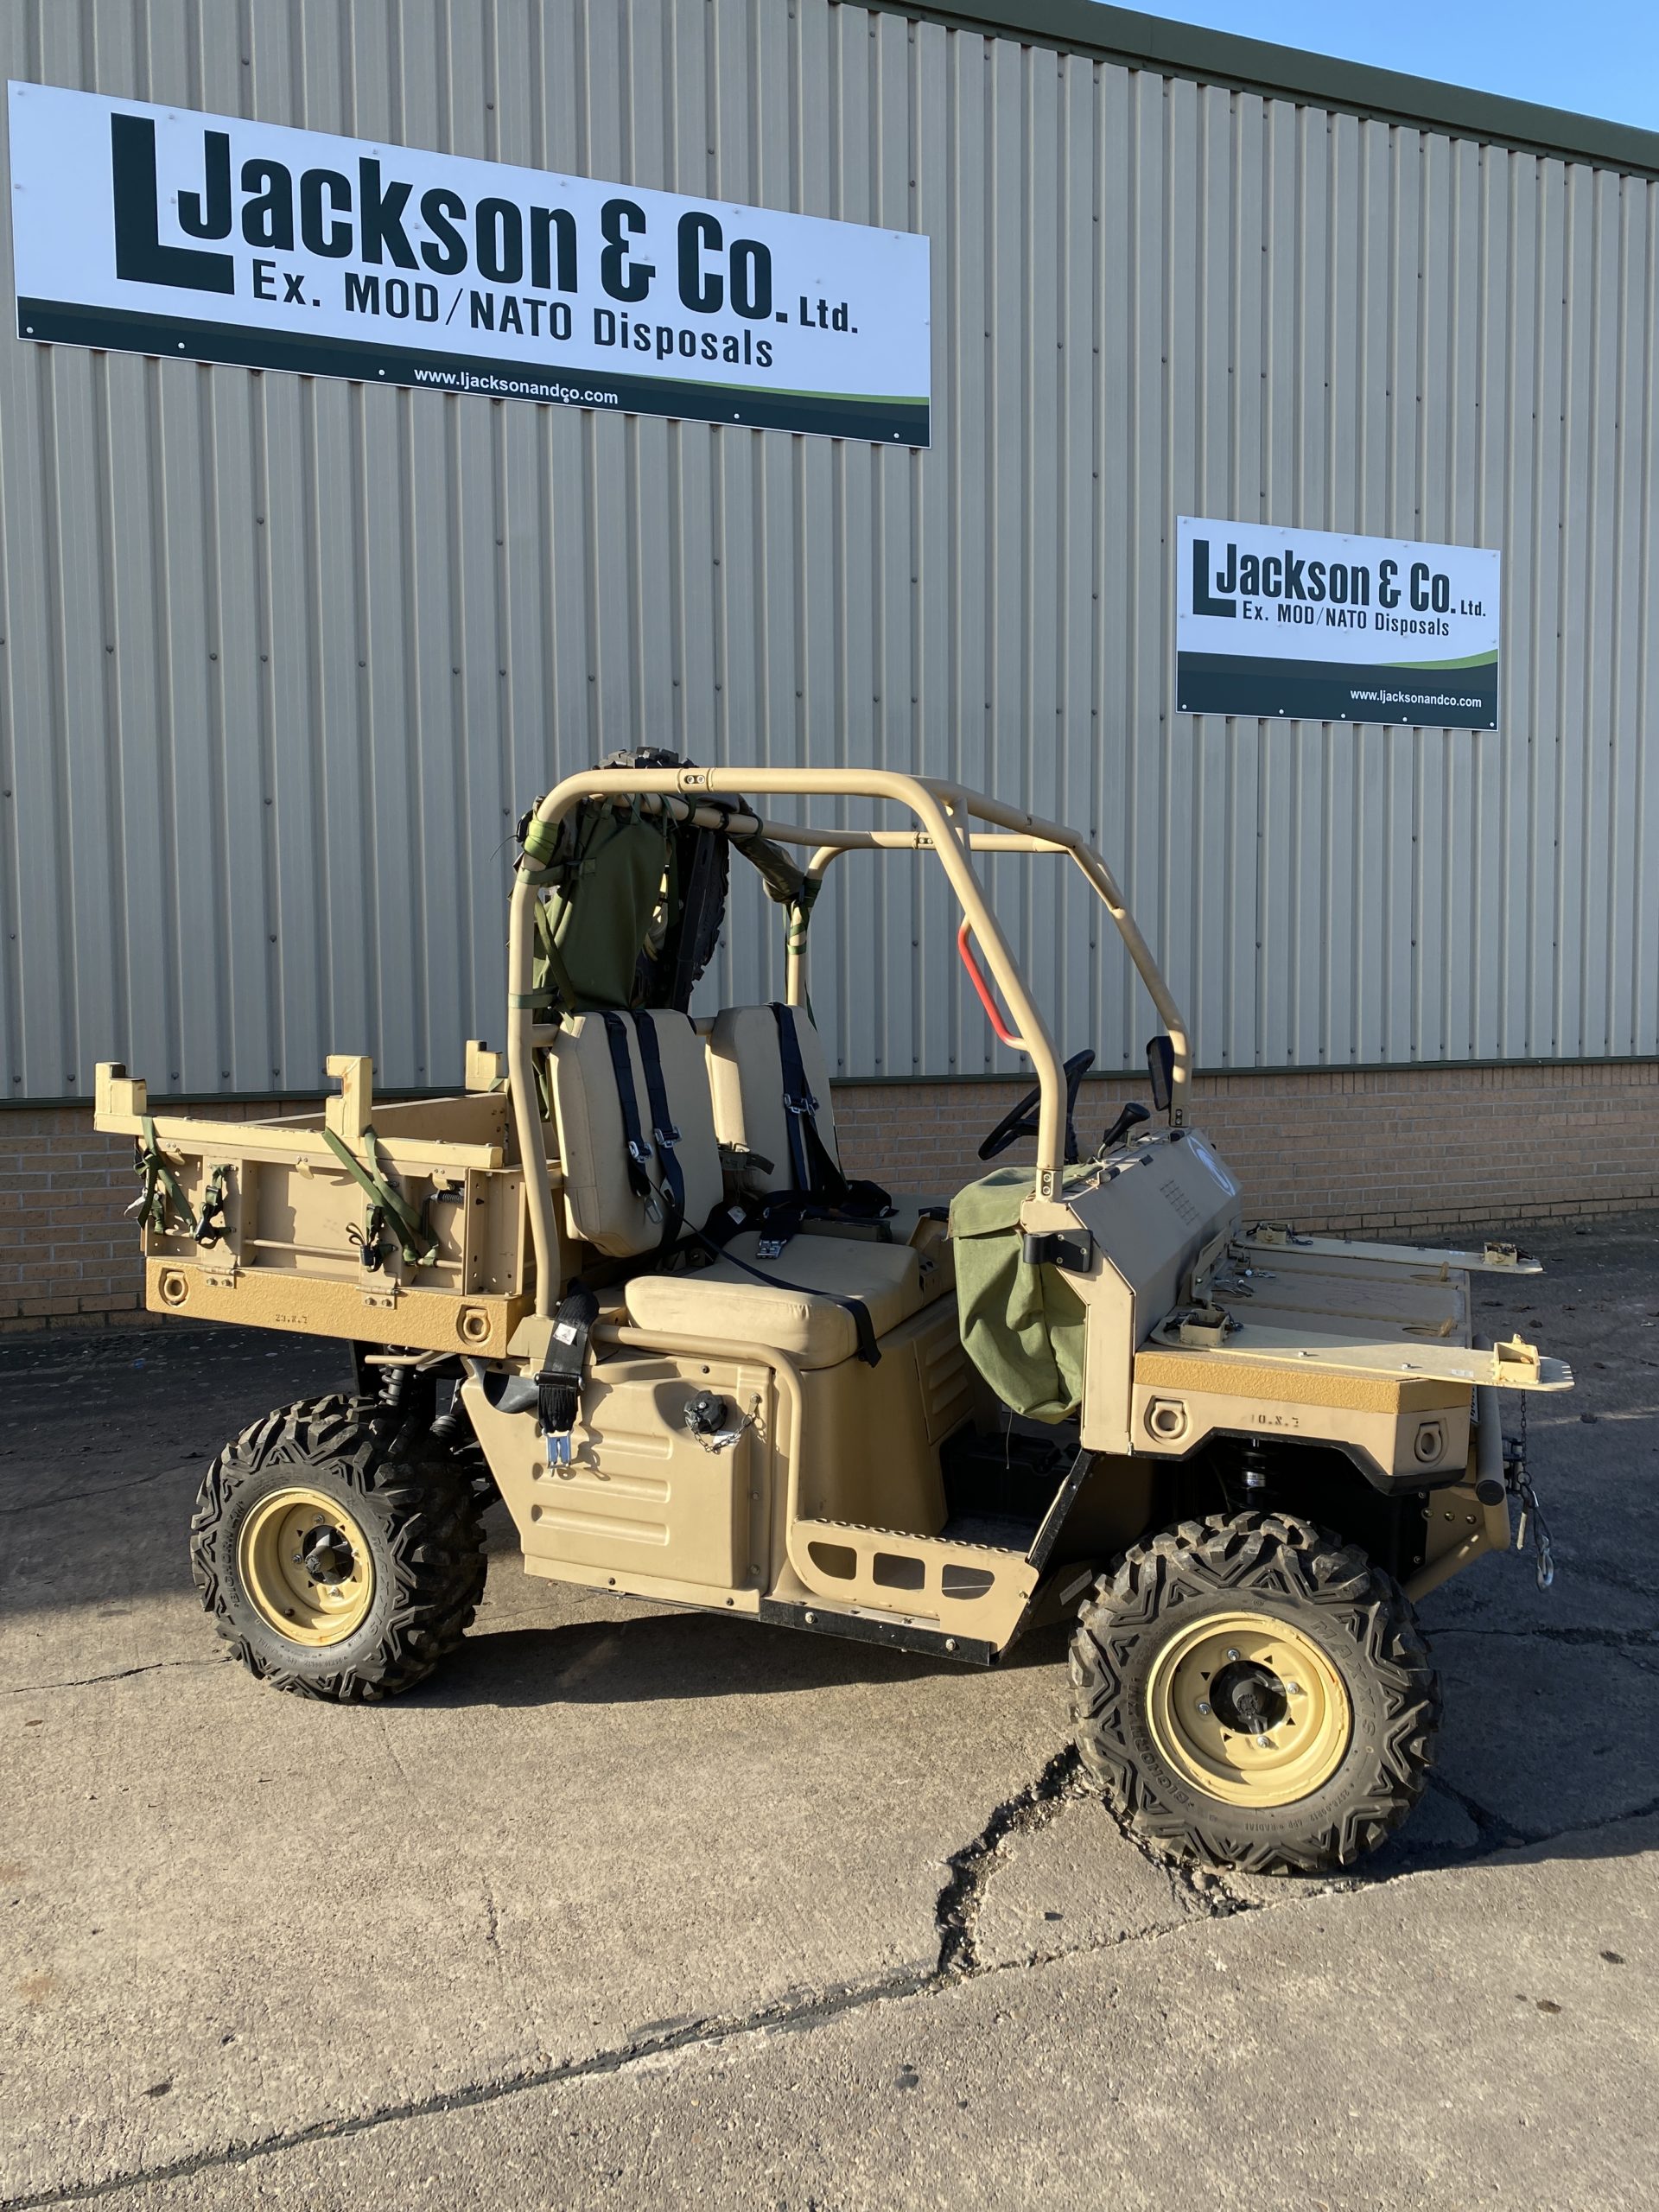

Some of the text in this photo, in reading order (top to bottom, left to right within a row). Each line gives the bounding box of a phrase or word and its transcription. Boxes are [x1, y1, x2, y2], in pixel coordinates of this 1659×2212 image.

[601, 199, 656, 302] &
[678, 212, 788, 324] Co.
[799, 296, 858, 334] Ltd.
[252, 259, 772, 368] Ex. MOD/NATO Disposals
[413, 369, 620, 404] www.ljacksonandco.com
[1378, 559, 1402, 608] &
[1409, 563, 1456, 614] Co.
[1460, 600, 1487, 617] Ltd.
[1243, 601, 1449, 636] Ex. MOD/NATO Disposals
[1350, 690, 1482, 708] www.ljacksonandco.com
[1310, 1620, 1377, 1738] MAXXIS
